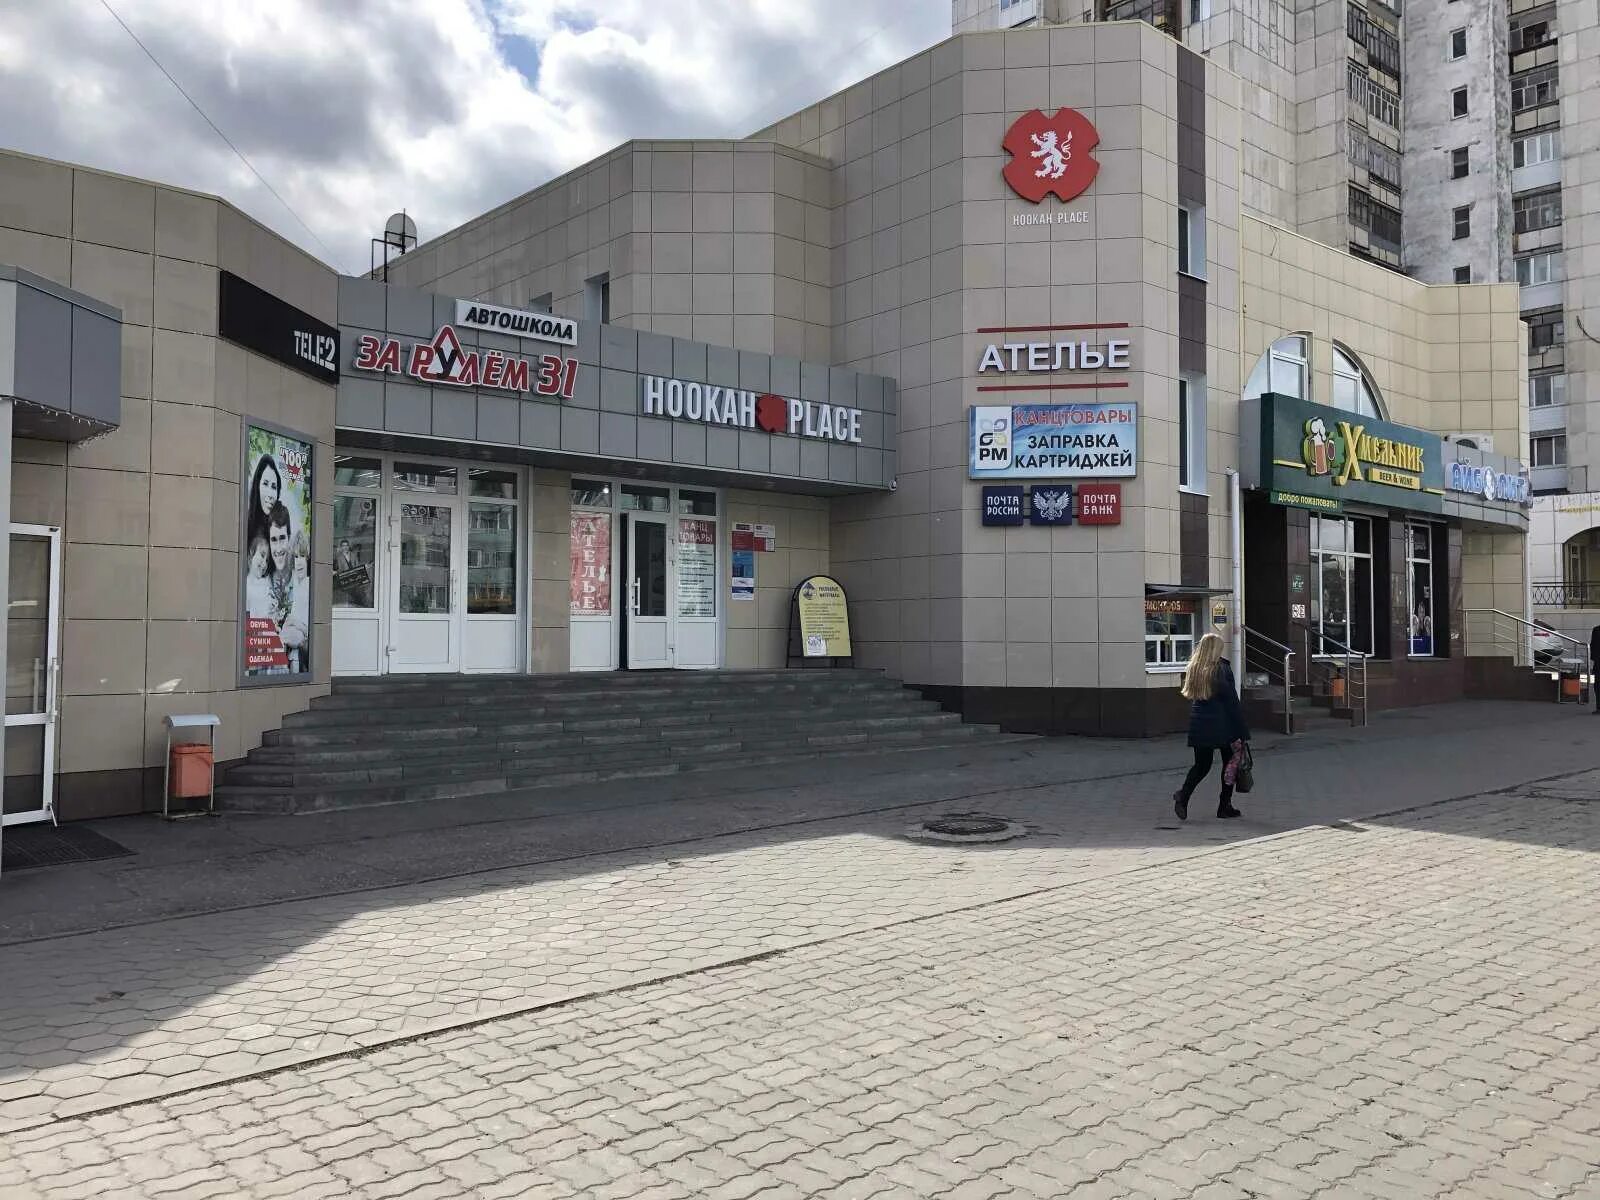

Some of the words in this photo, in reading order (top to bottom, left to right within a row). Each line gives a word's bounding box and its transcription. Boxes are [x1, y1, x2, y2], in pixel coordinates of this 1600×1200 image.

[1013, 213, 1052, 226] HOOKAH
[1057, 211, 1089, 224] PLACE
[465, 306, 573, 339] АВТОШКОЛА
[294, 330, 336, 371] TELE2
[978, 339, 1131, 372] АТЕЛЬЕ
[355, 335, 401, 373] ЗА
[407, 341, 530, 392] РУЛЁМ
[537, 354, 578, 397] 31
[643, 375, 756, 428] HOOKAH
[786, 399, 862, 443] PLACE
[1015, 409, 1132, 426] КАНЦТОВАРЫ
[1027, 433, 1120, 449] ЗАПРАВКА
[1014, 449, 1132, 470] КАРТРИДЖЕЙ
[987, 496, 1019, 506] ПОЧТА
[1083, 494, 1116, 505] ПОЧТА
[987, 507, 1019, 516] РОССИИ
[1083, 505, 1113, 515] БАНК
[582, 519, 596, 609] АТЕЛЬЕ
